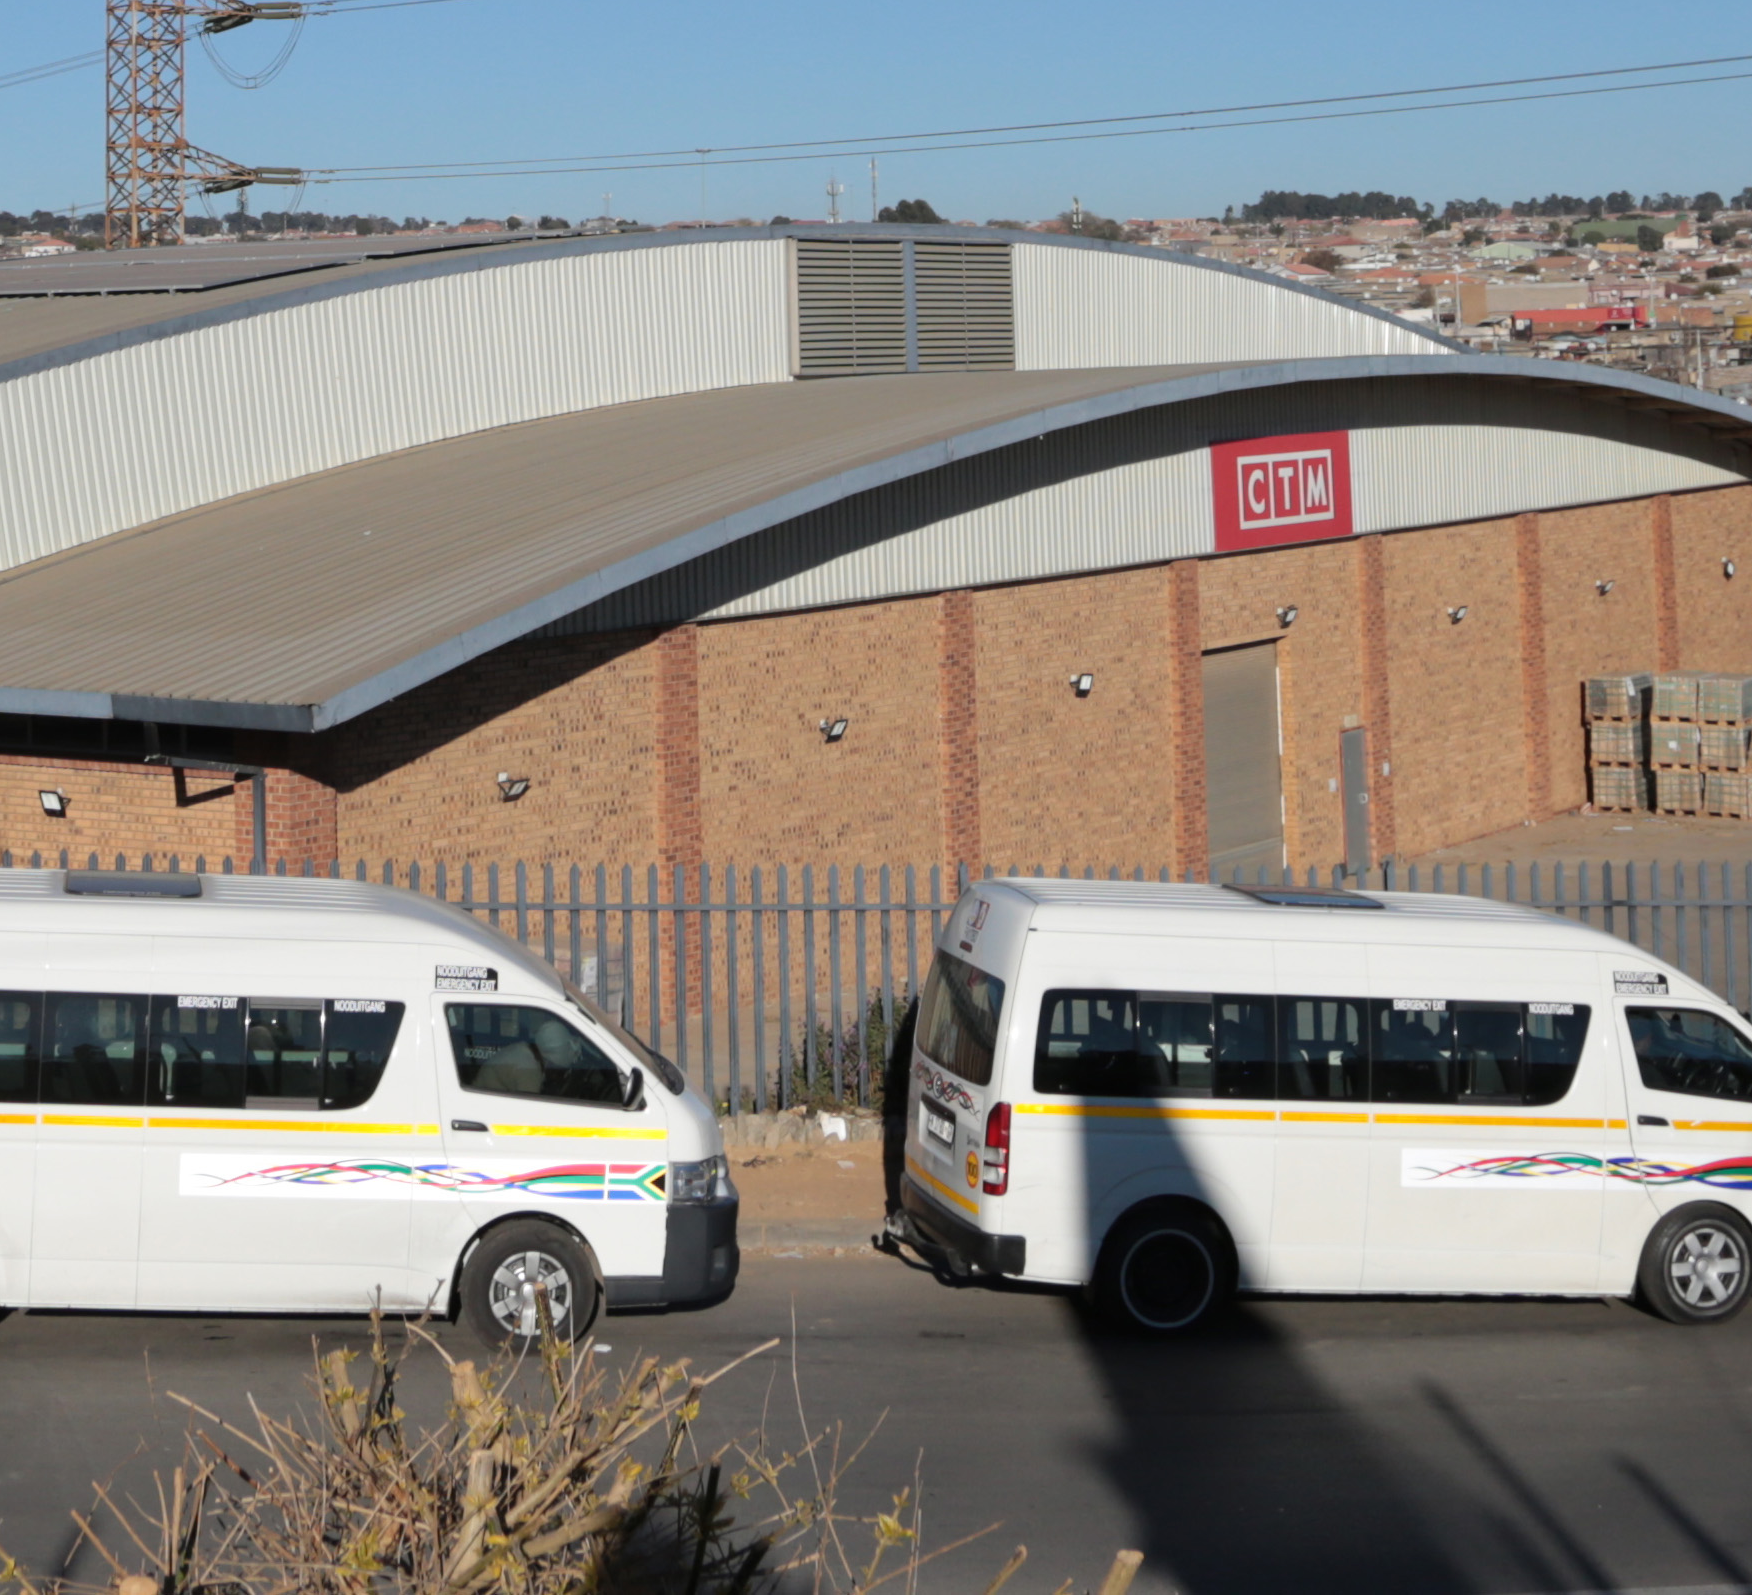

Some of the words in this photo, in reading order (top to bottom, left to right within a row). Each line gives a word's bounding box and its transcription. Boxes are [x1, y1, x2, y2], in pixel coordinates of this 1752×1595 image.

[1248, 464, 1327, 514] CTM
[437, 965, 488, 978] NOODUITGANG
[436, 977, 480, 990] EMERGENCY
[480, 979, 496, 991] EXIT
[178, 996, 222, 1008] EMERGENCY
[222, 997, 237, 1009] EXIT
[334, 1000, 386, 1013] NOODUITGANG
[1393, 999, 1432, 1011] EMERGENCY
